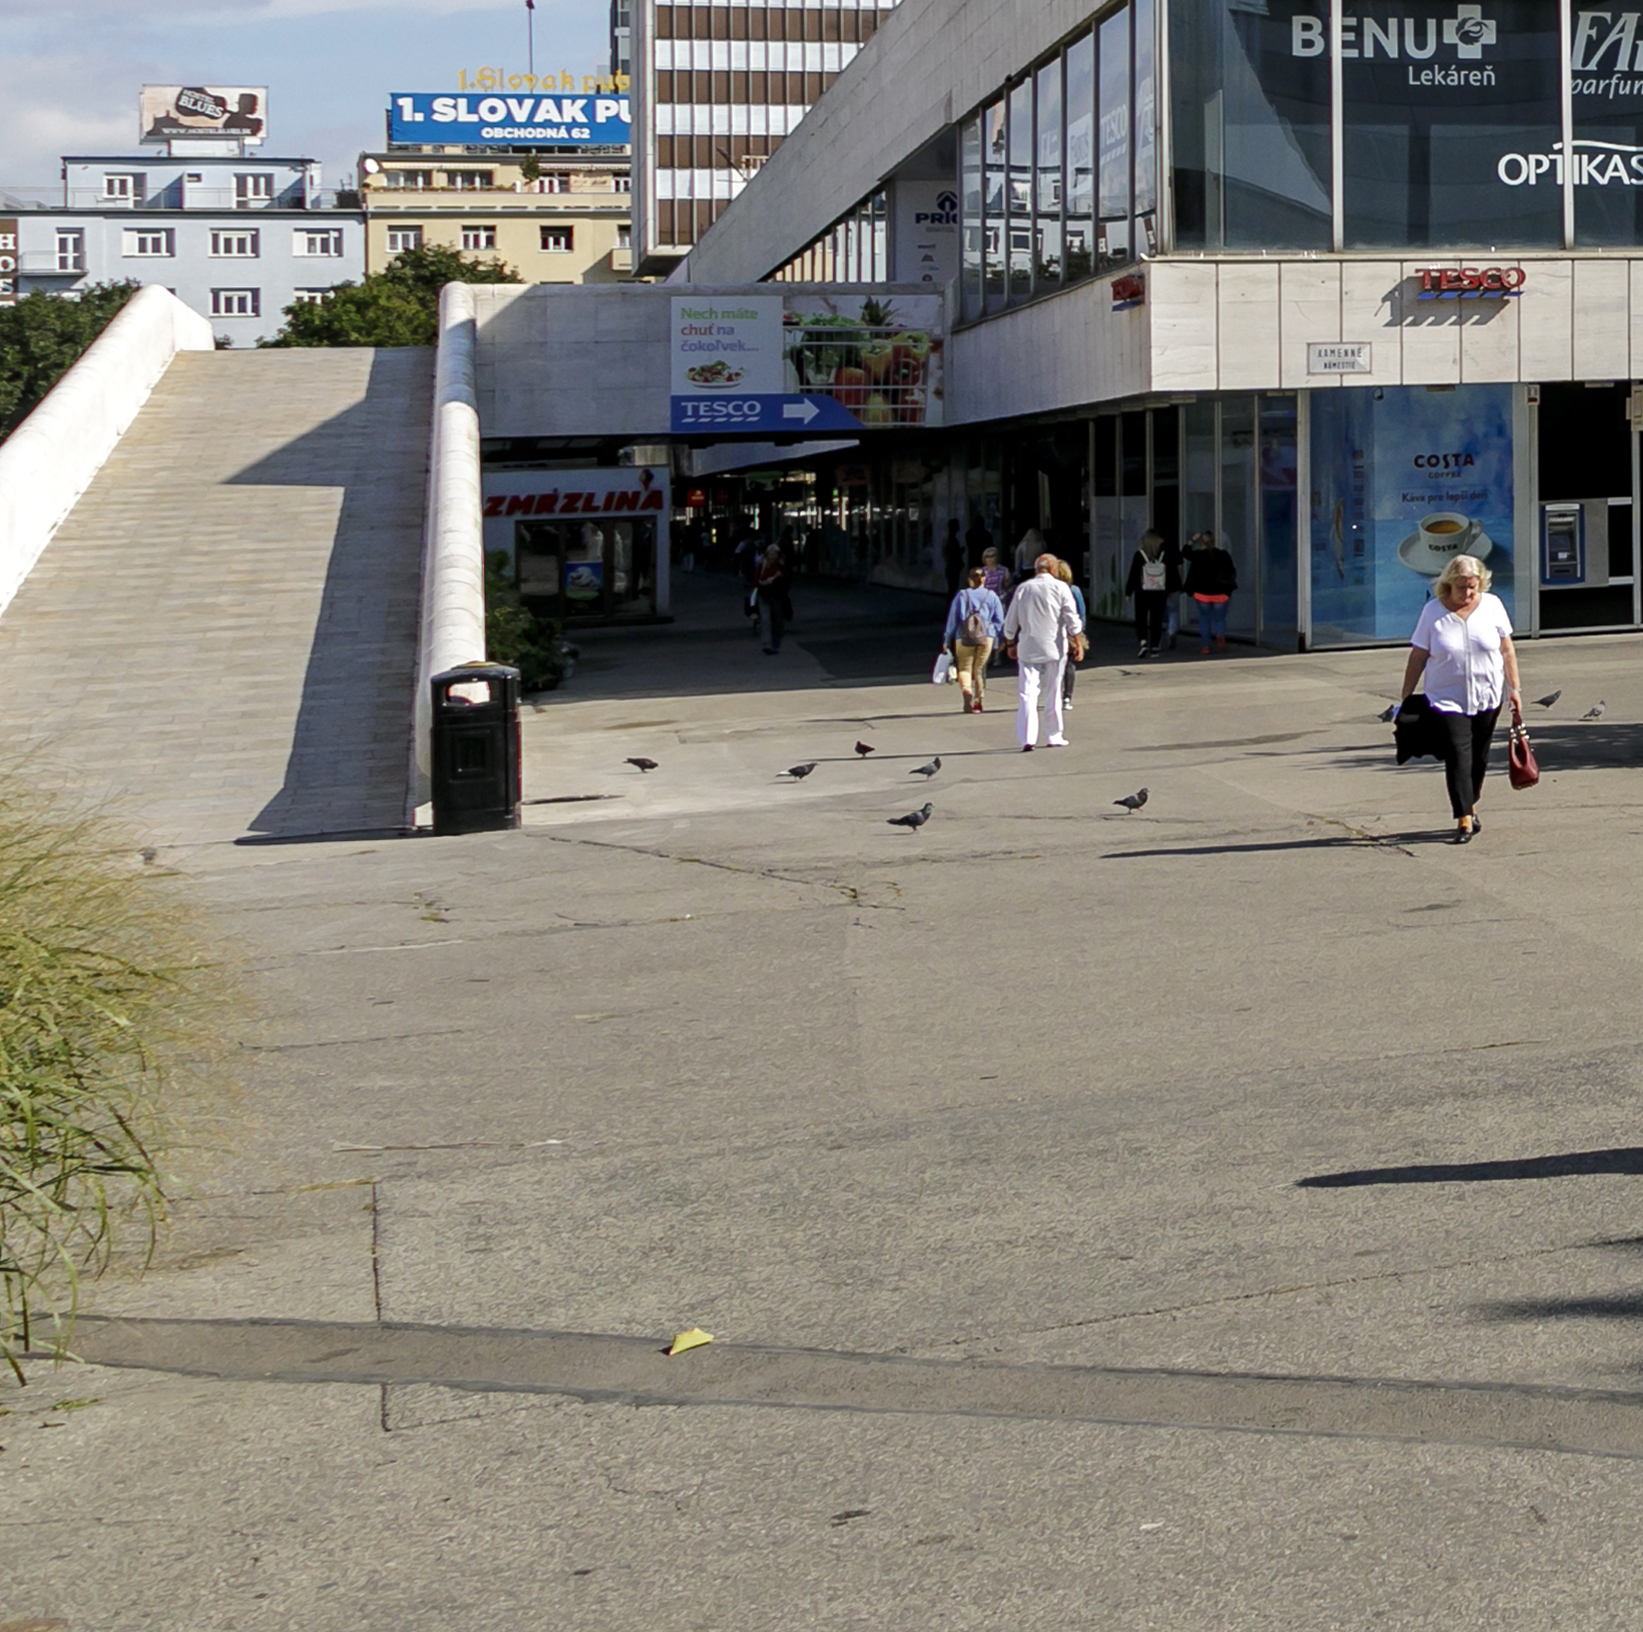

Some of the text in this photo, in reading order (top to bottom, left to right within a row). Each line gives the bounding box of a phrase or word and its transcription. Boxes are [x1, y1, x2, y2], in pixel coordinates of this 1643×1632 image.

[1291, 15, 1437, 59] BENU
[583, 68, 631, 93] pub
[1408, 64, 1495, 86] Lekáreň
[178, 95, 225, 118] BLUES
[397, 97, 631, 123] 1. SLOVAK PU
[481, 125, 591, 139] OBCHODNÁ 62
[915, 212, 958, 225] PRI
[1415, 266, 1527, 290] TESCO
[680, 307, 758, 320] Nech máte
[680, 322, 735, 336] chuť na
[1317, 346, 1362, 358] KAMENNÉ
[1323, 360, 1356, 370] NÁMESTIE
[681, 400, 761, 416] TESCO
[1413, 453, 1475, 469] COSTA
[1402, 492, 1425, 503] Káva
[1428, 494, 1444, 505] pre
[1446, 490, 1468, 504] lepší
[1428, 543, 1458, 552] COSTA
